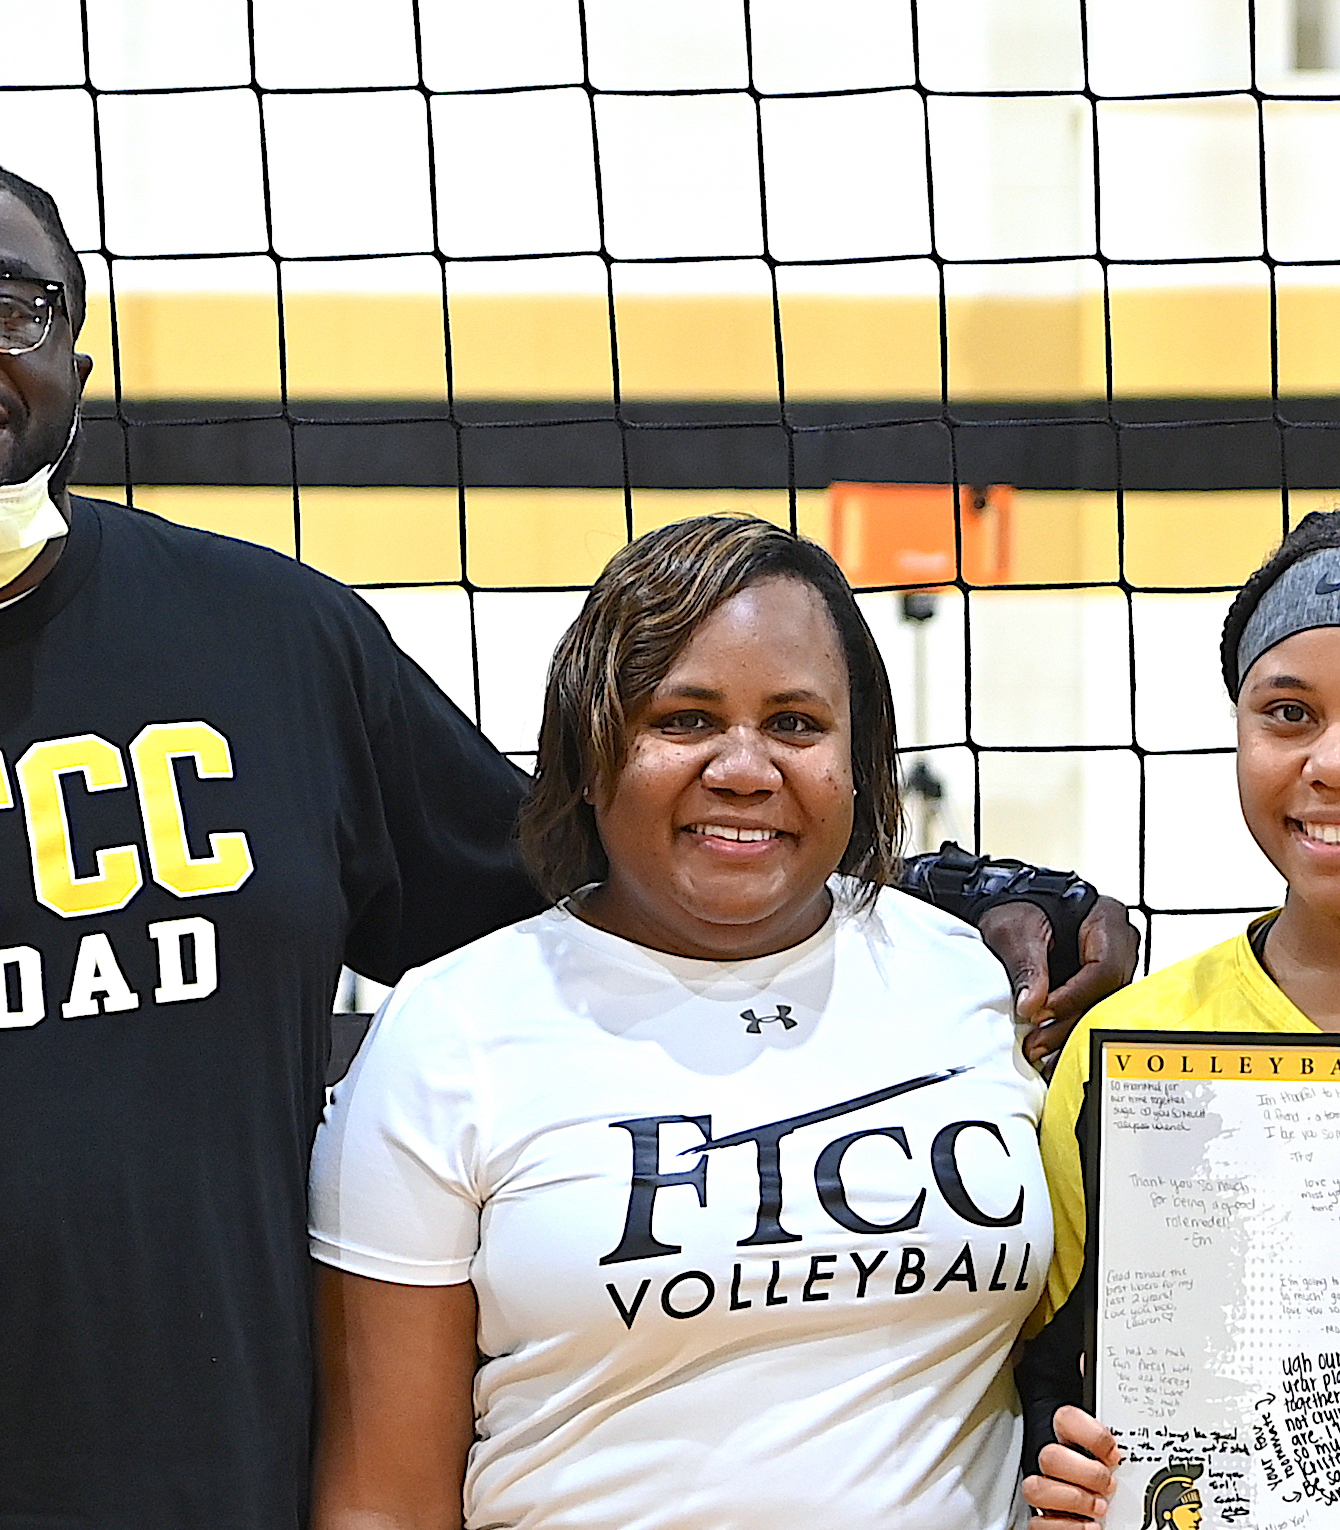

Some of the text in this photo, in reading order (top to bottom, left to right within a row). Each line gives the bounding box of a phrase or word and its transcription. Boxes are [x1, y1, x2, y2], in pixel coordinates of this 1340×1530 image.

[1264, 1126, 1275, 1139] I
[599, 1065, 1025, 1266] FTCC
[1130, 1174, 1193, 1194] Thank you
[1305, 1179, 1326, 1187] love
[1150, 1192, 1166, 1208] for
[1221, 1198, 1255, 1216] good
[606, 1243, 1032, 1330] VOLLEYBALL
[1179, 1279, 1194, 1291] my
[1280, 1278, 1299, 1287] I'm
[1302, 1278, 1327, 1291] going
[1332, 1276, 1339, 1285] to
[1132, 1293, 1139, 1304] 2
[1283, 1305, 1301, 1315] love
[1107, 1346, 1117, 1357] I
[1125, 1346, 1141, 1356] had
[1318, 1351, 1340, 1370] our
[1118, 1382, 1138, 1392] from
[1282, 1377, 1317, 1400] year
[1285, 1414, 1309, 1432] not
[1129, 1427, 1149, 1439] will
[1292, 1429, 1324, 1446] are.
[1326, 1424, 1333, 1440] I
[1262, 1412, 1295, 1479] roommate
[1293, 1446, 1310, 1466] so
[1303, 1477, 1325, 1498] Be
